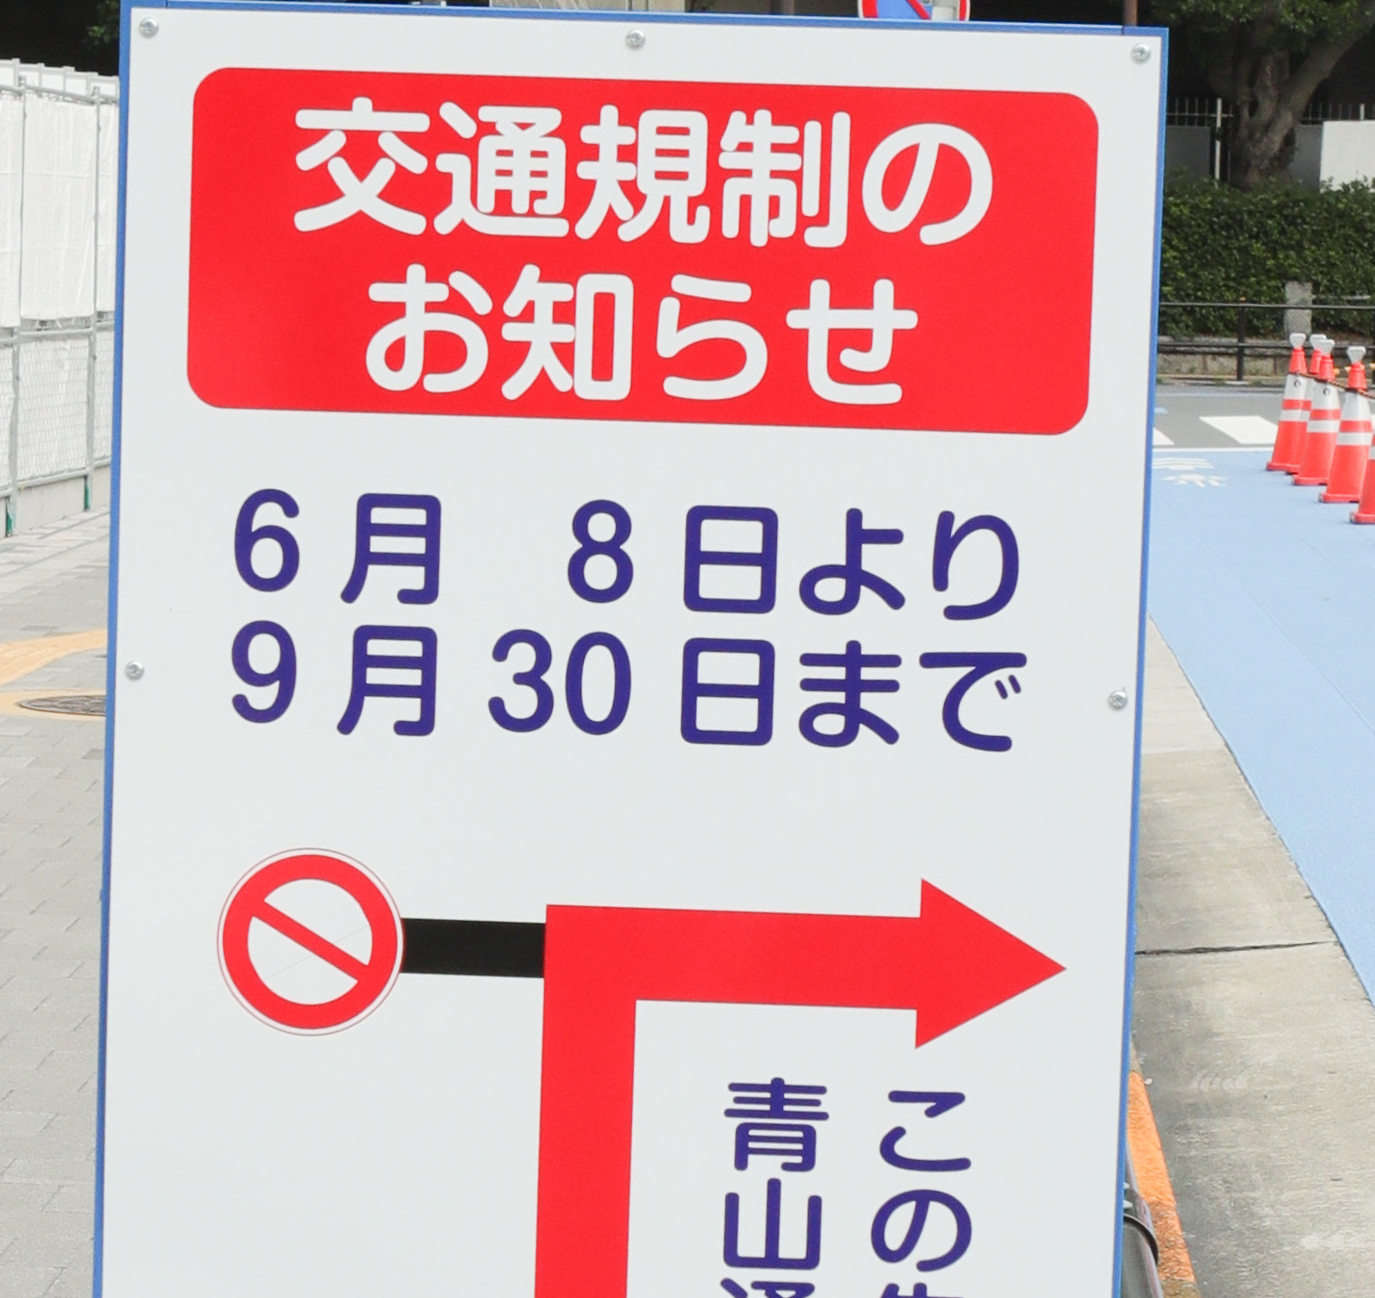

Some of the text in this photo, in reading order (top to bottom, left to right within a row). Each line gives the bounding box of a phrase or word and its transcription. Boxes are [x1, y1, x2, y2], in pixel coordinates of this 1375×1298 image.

[294, 97, 994, 248] 交通規制の
[367, 263, 918, 405] お知らせ
